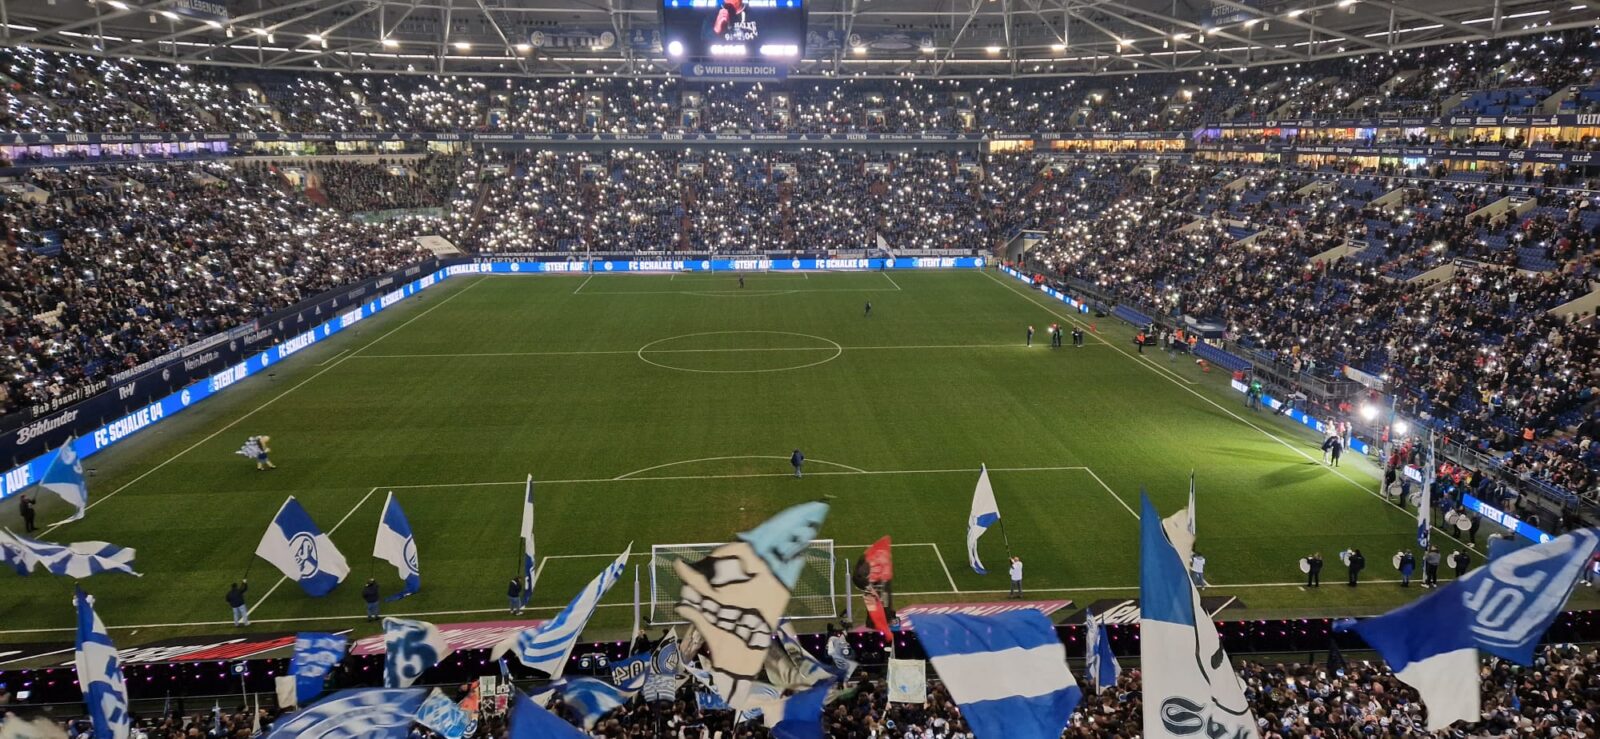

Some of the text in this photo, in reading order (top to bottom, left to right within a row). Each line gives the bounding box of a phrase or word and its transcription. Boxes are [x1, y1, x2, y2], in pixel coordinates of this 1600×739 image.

[450, 263, 480, 275] SCHALKE
[481, 262, 492, 272] 04
[545, 262, 584, 271] STEHT AUF
[629, 261, 684, 270] FC SCHALKE 04
[735, 260, 773, 269] STEHT AUF
[816, 260, 868, 268] FC SCHALKE 04
[918, 258, 955, 267] STEHT AUF
[184, 351, 219, 372] MeinAuto.de
[213, 361, 247, 391] STEHT AUF
[32, 404, 49, 418] Bad
[16, 409, 79, 445] Böklunder
[94, 402, 163, 449] FC SCHALKE 04
[6, 463, 30, 494] AUF
[1479, 502, 1518, 531] STEHT AUF
